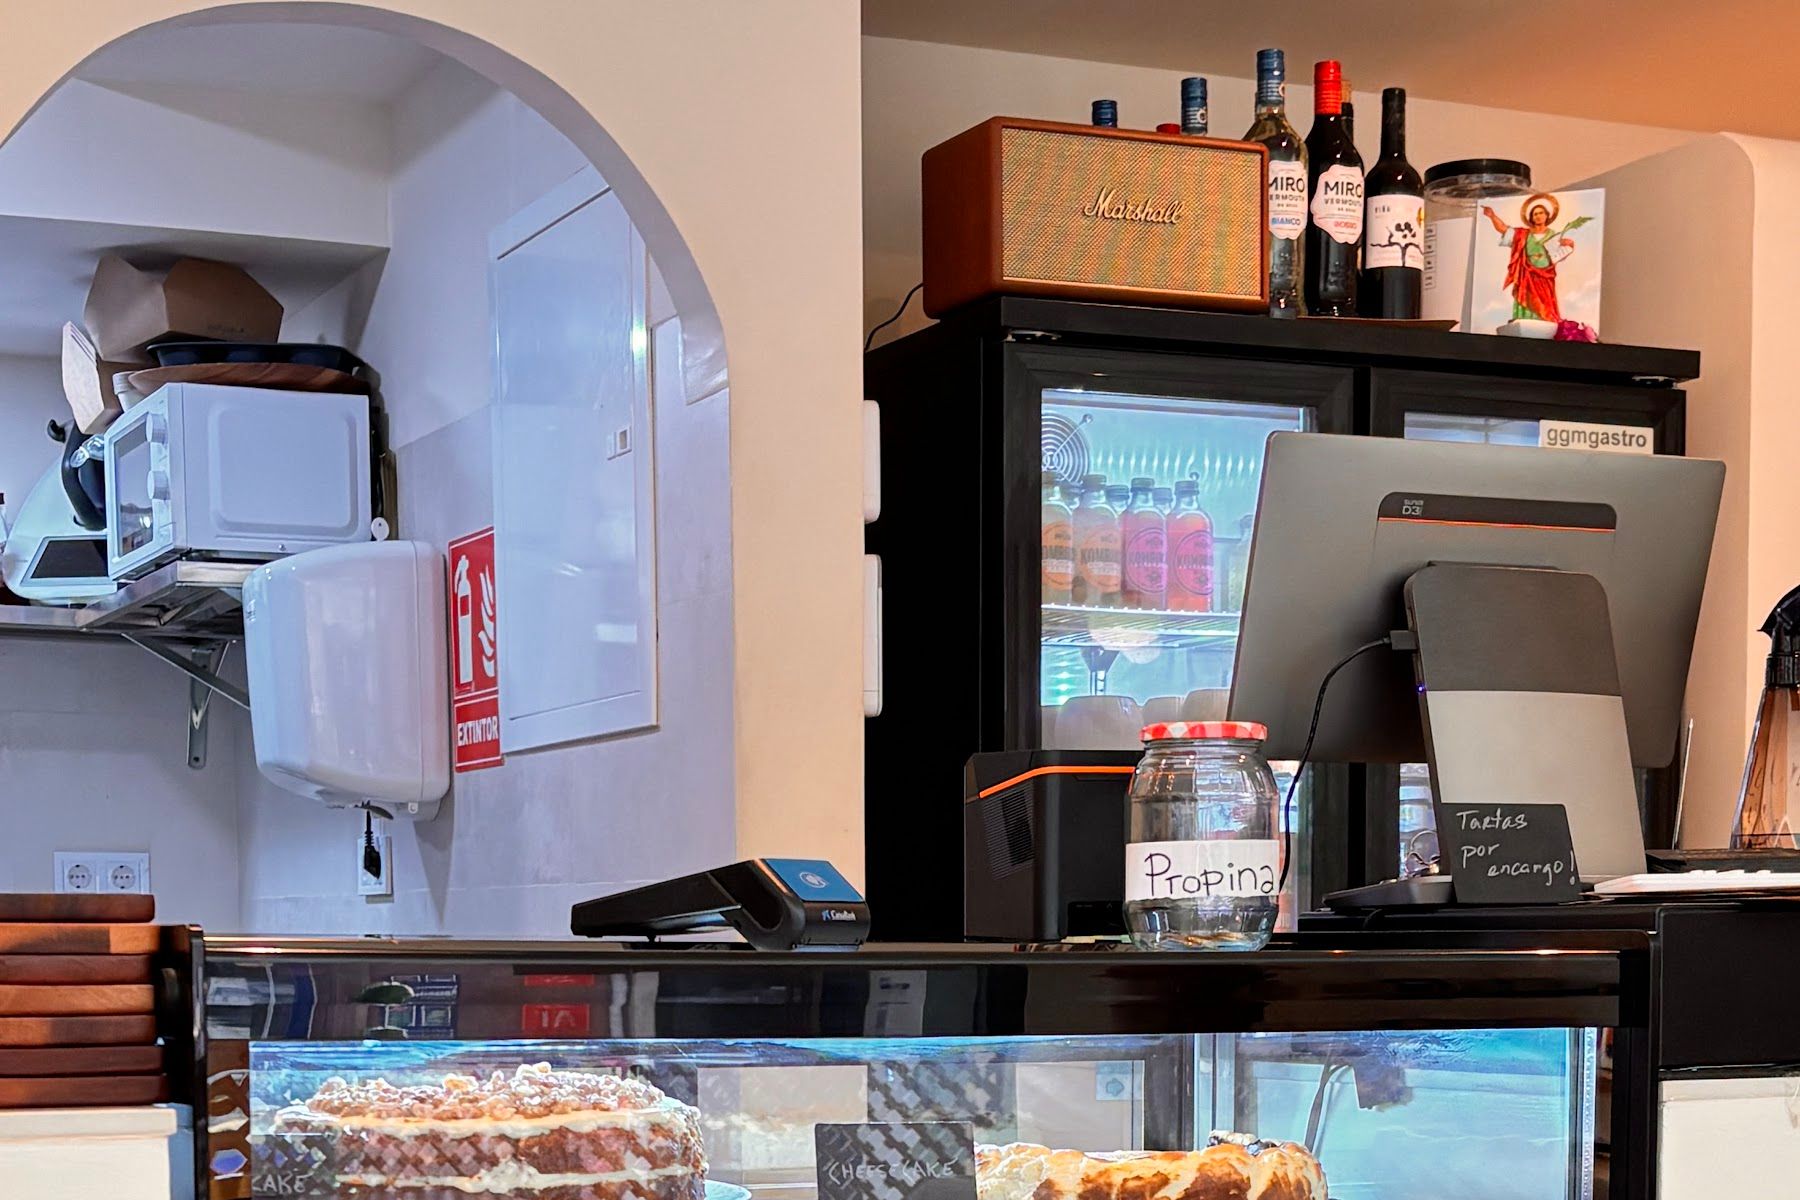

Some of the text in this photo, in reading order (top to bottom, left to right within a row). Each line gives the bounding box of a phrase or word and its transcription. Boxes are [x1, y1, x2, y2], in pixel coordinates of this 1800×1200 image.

[1083, 186, 1184, 224] Marshall
[1547, 427, 1648, 449] ggmgastro
[458, 716, 499, 746] EXTINTOR
[1456, 808, 1528, 830] Tartas
[1461, 843, 1500, 868] por
[1144, 853, 1274, 896] Propina
